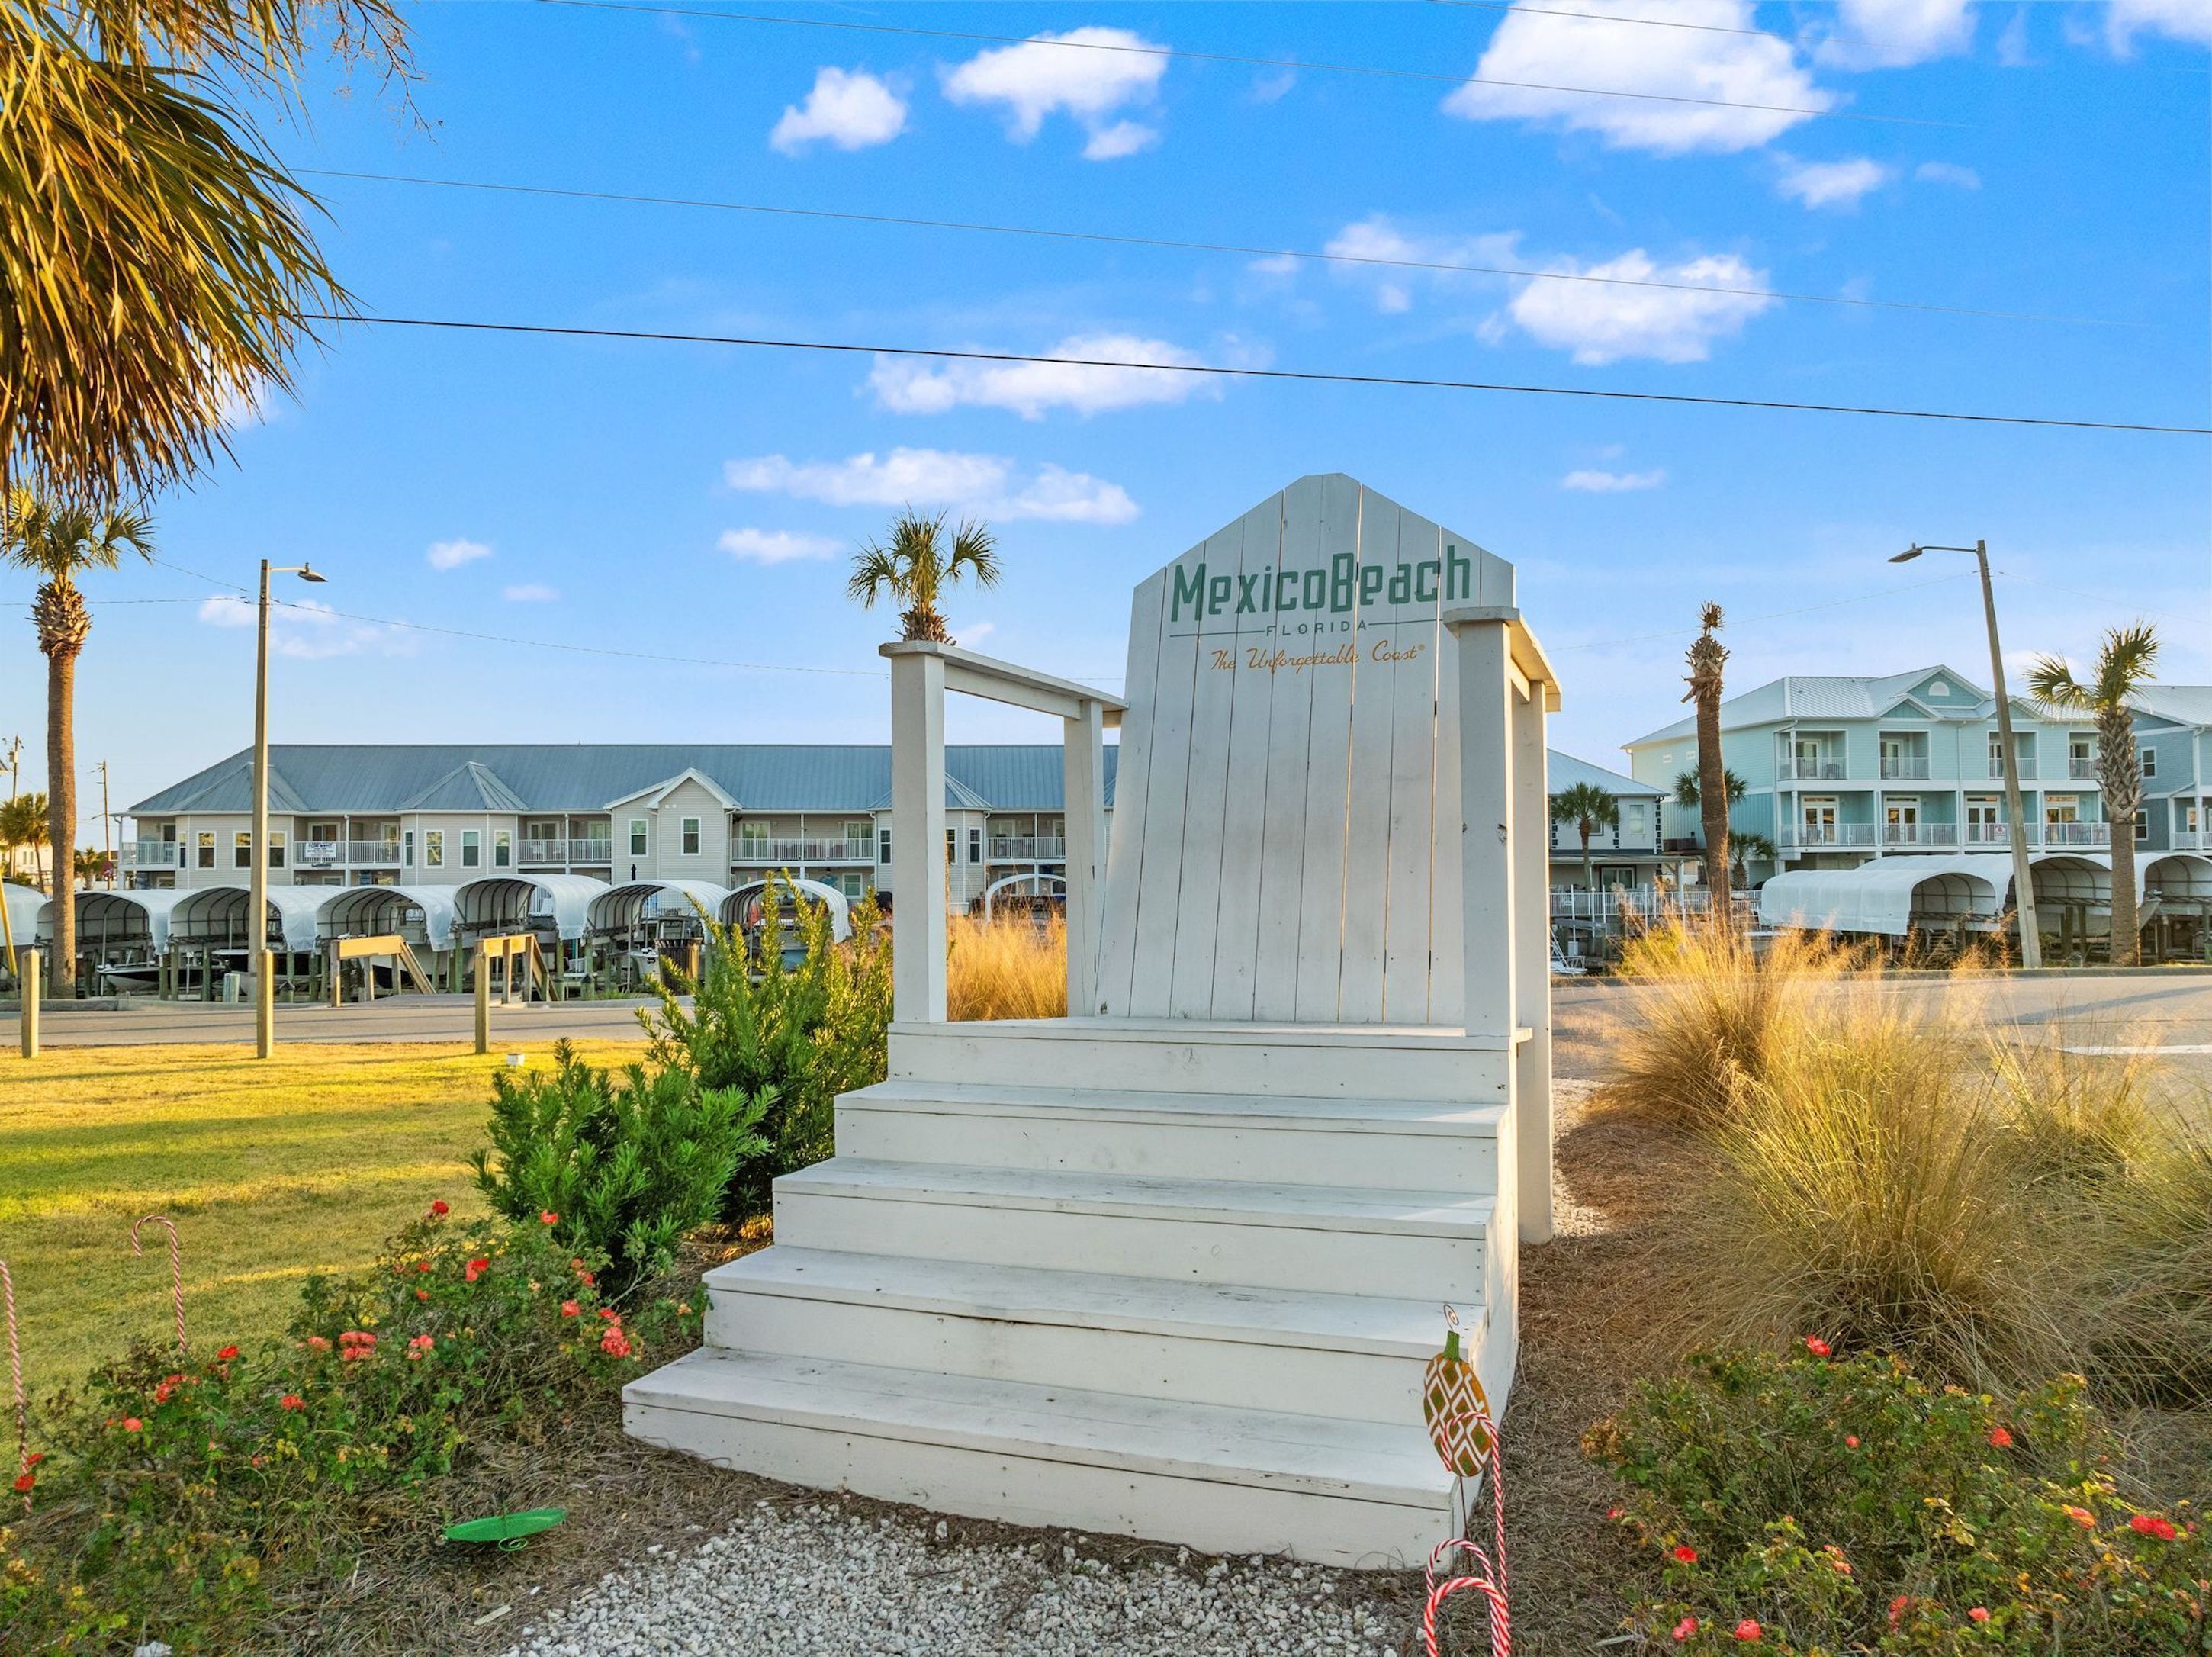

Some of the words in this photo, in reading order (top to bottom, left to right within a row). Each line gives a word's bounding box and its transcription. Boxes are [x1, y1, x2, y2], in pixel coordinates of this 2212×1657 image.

[1266, 619, 1368, 637] FLORIDA
[1210, 649, 1236, 671] The
[1246, 642, 1360, 675] Unforgettable
